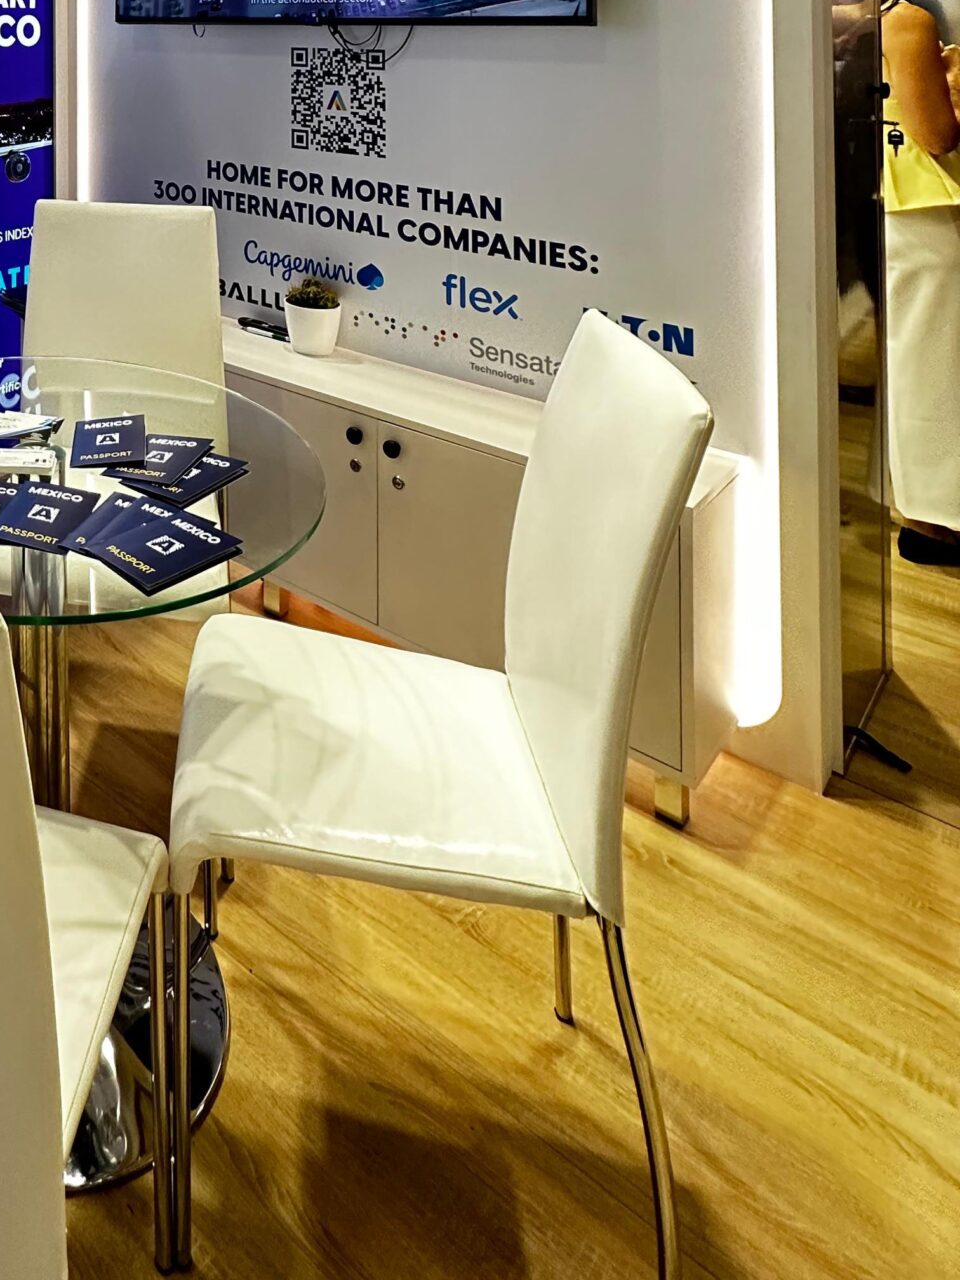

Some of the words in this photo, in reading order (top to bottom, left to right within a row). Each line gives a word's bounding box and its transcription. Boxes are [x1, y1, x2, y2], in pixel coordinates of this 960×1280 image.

[207, 160, 271, 187] HOME
[277, 169, 324, 195] FOR
[331, 176, 410, 208] MORE
[417, 186, 502, 221] THAN
[5, 226, 34, 241] INDEX
[154, 180, 196, 204] 300
[202, 187, 390, 238] INTERNATIONAL
[397, 218, 599, 274] COMPANIES:
[244, 239, 355, 285] Capgemini
[442, 273, 519, 320] flex
[469, 361, 535, 386] Technologies
[84, 419, 133, 430] MEXICO
[148, 438, 198, 448] MEXICO
[79, 450, 133, 460] PASSPORT
[28, 486, 83, 503] MEXICO
[141, 503, 174, 519] MEX
[0, 525, 60, 546] PASSPORT
[171, 518, 222, 545] MEXICO
[105, 545, 156, 575] PASSPORT
